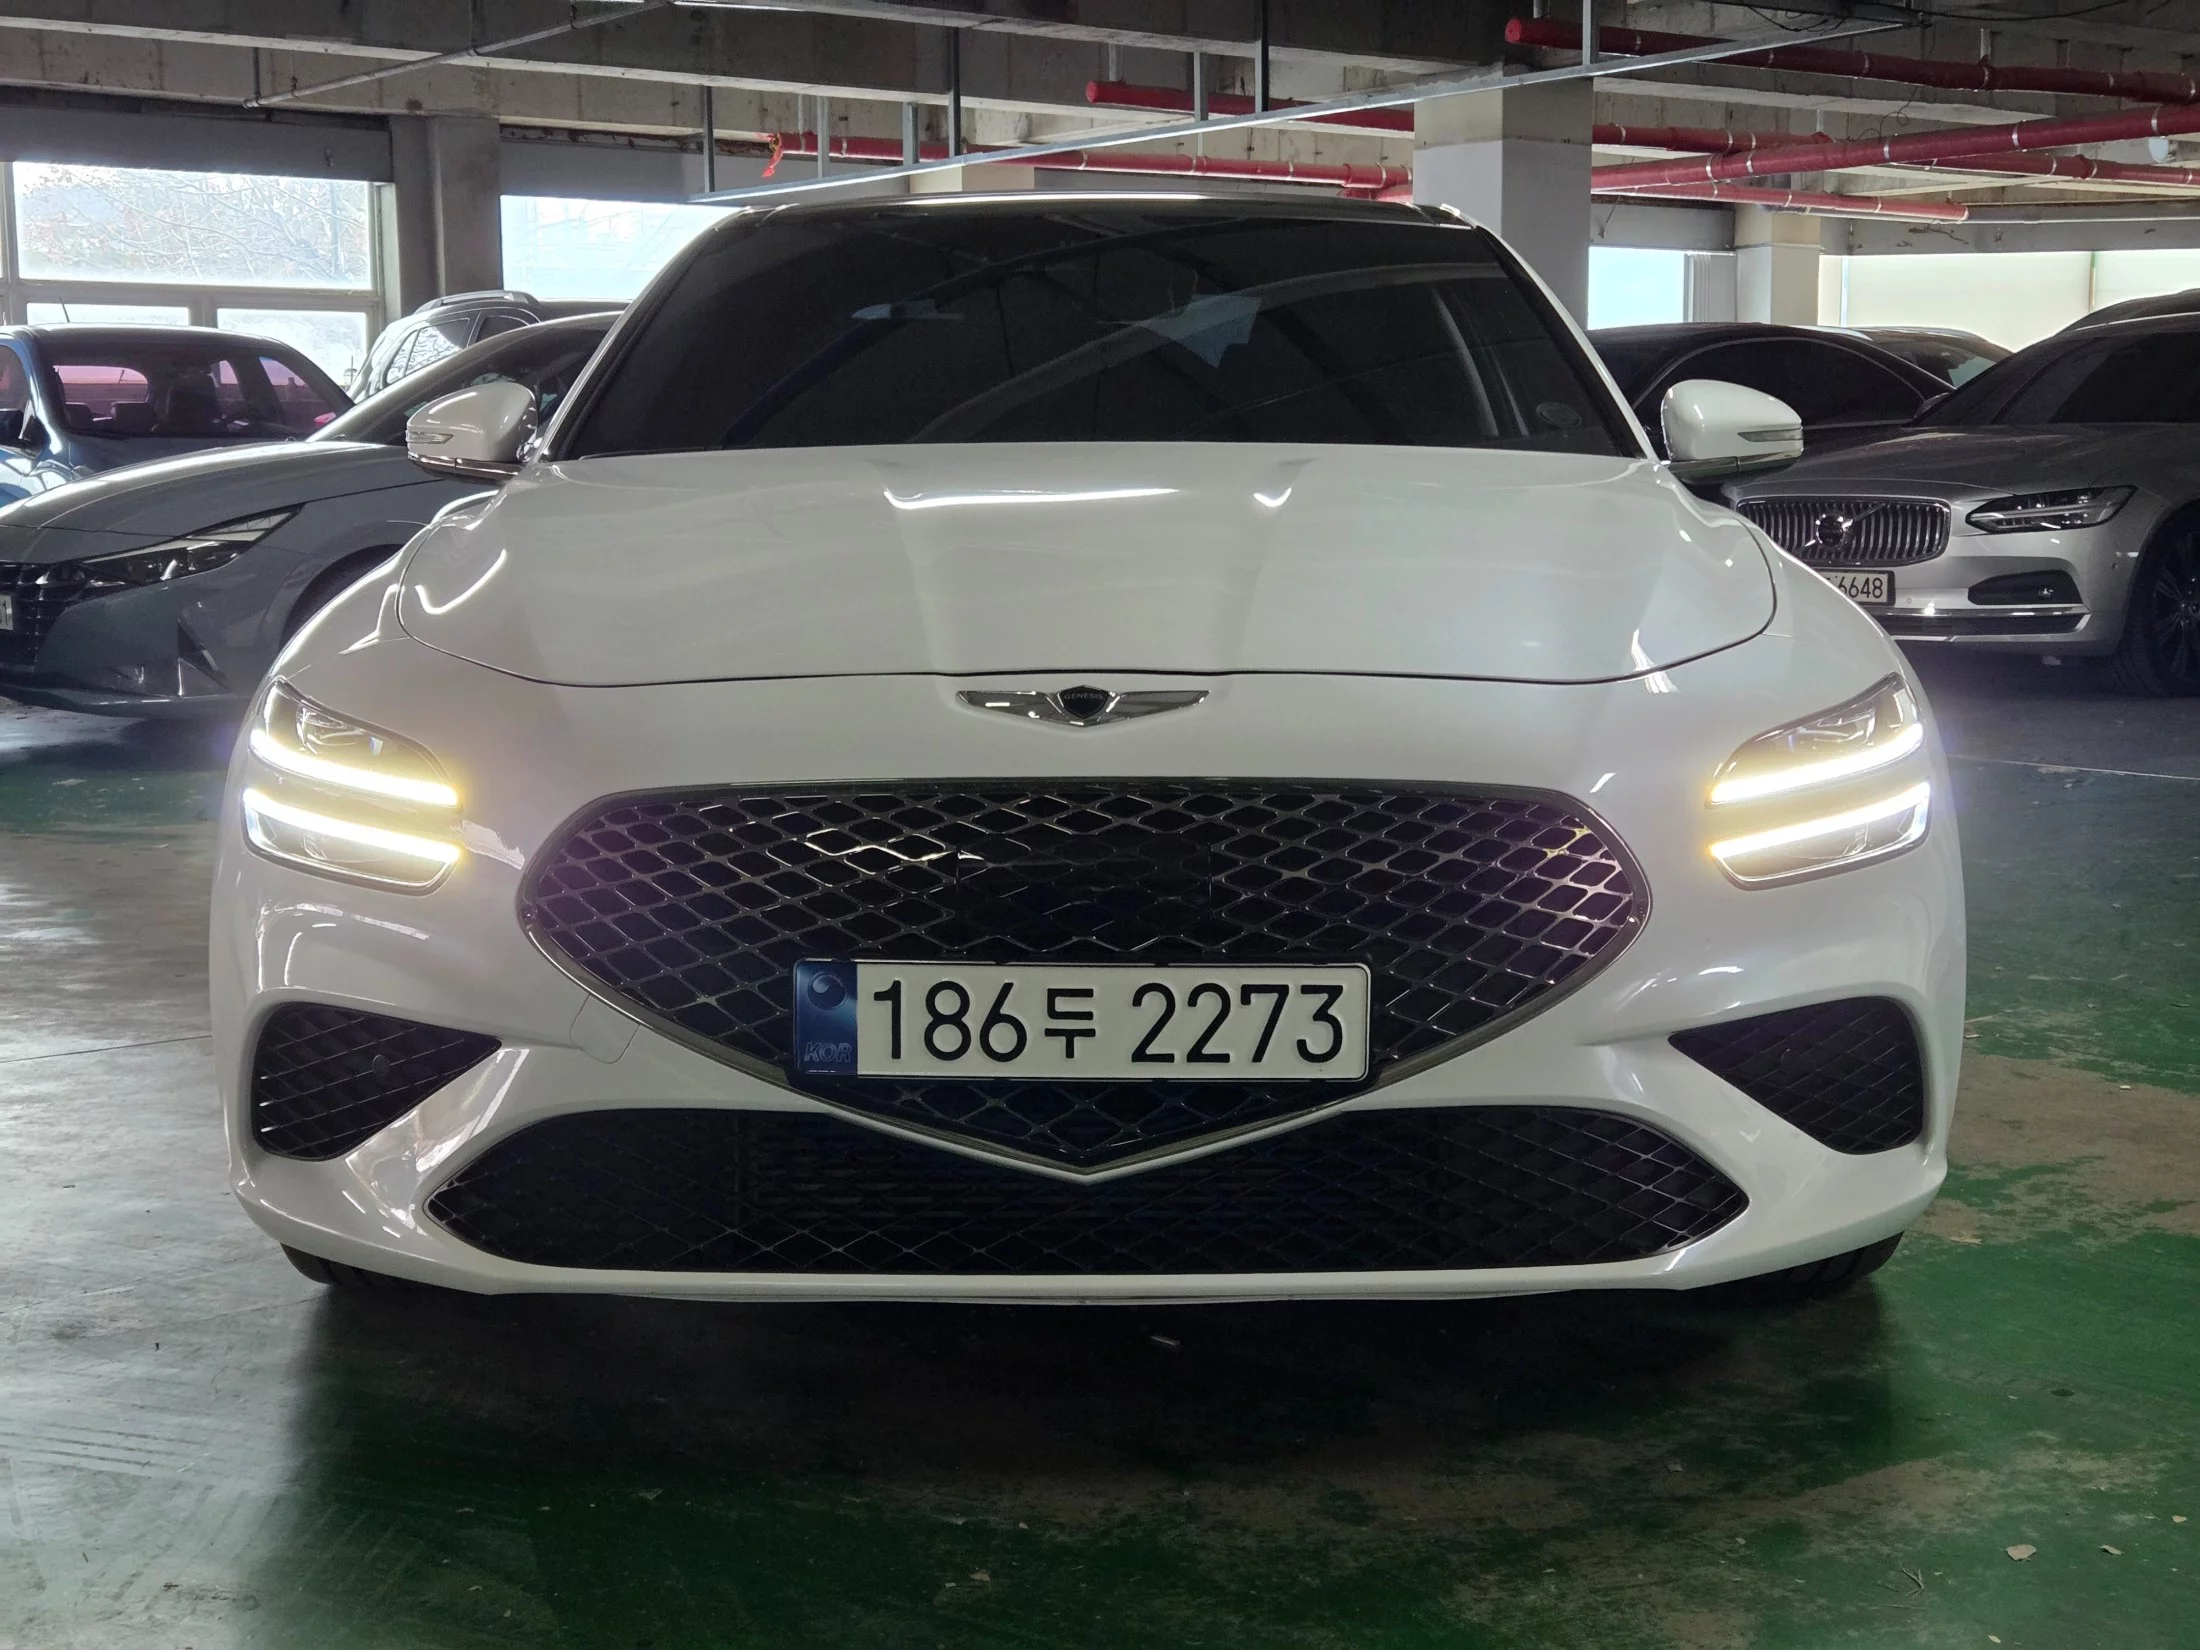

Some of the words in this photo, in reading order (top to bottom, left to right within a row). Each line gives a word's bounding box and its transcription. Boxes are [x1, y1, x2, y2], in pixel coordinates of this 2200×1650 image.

[1838, 576, 1883, 599] 6648
[873, 980, 1097, 1062] 186두
[1131, 982, 1344, 1063] 2273
[803, 1041, 852, 1063] KOR
